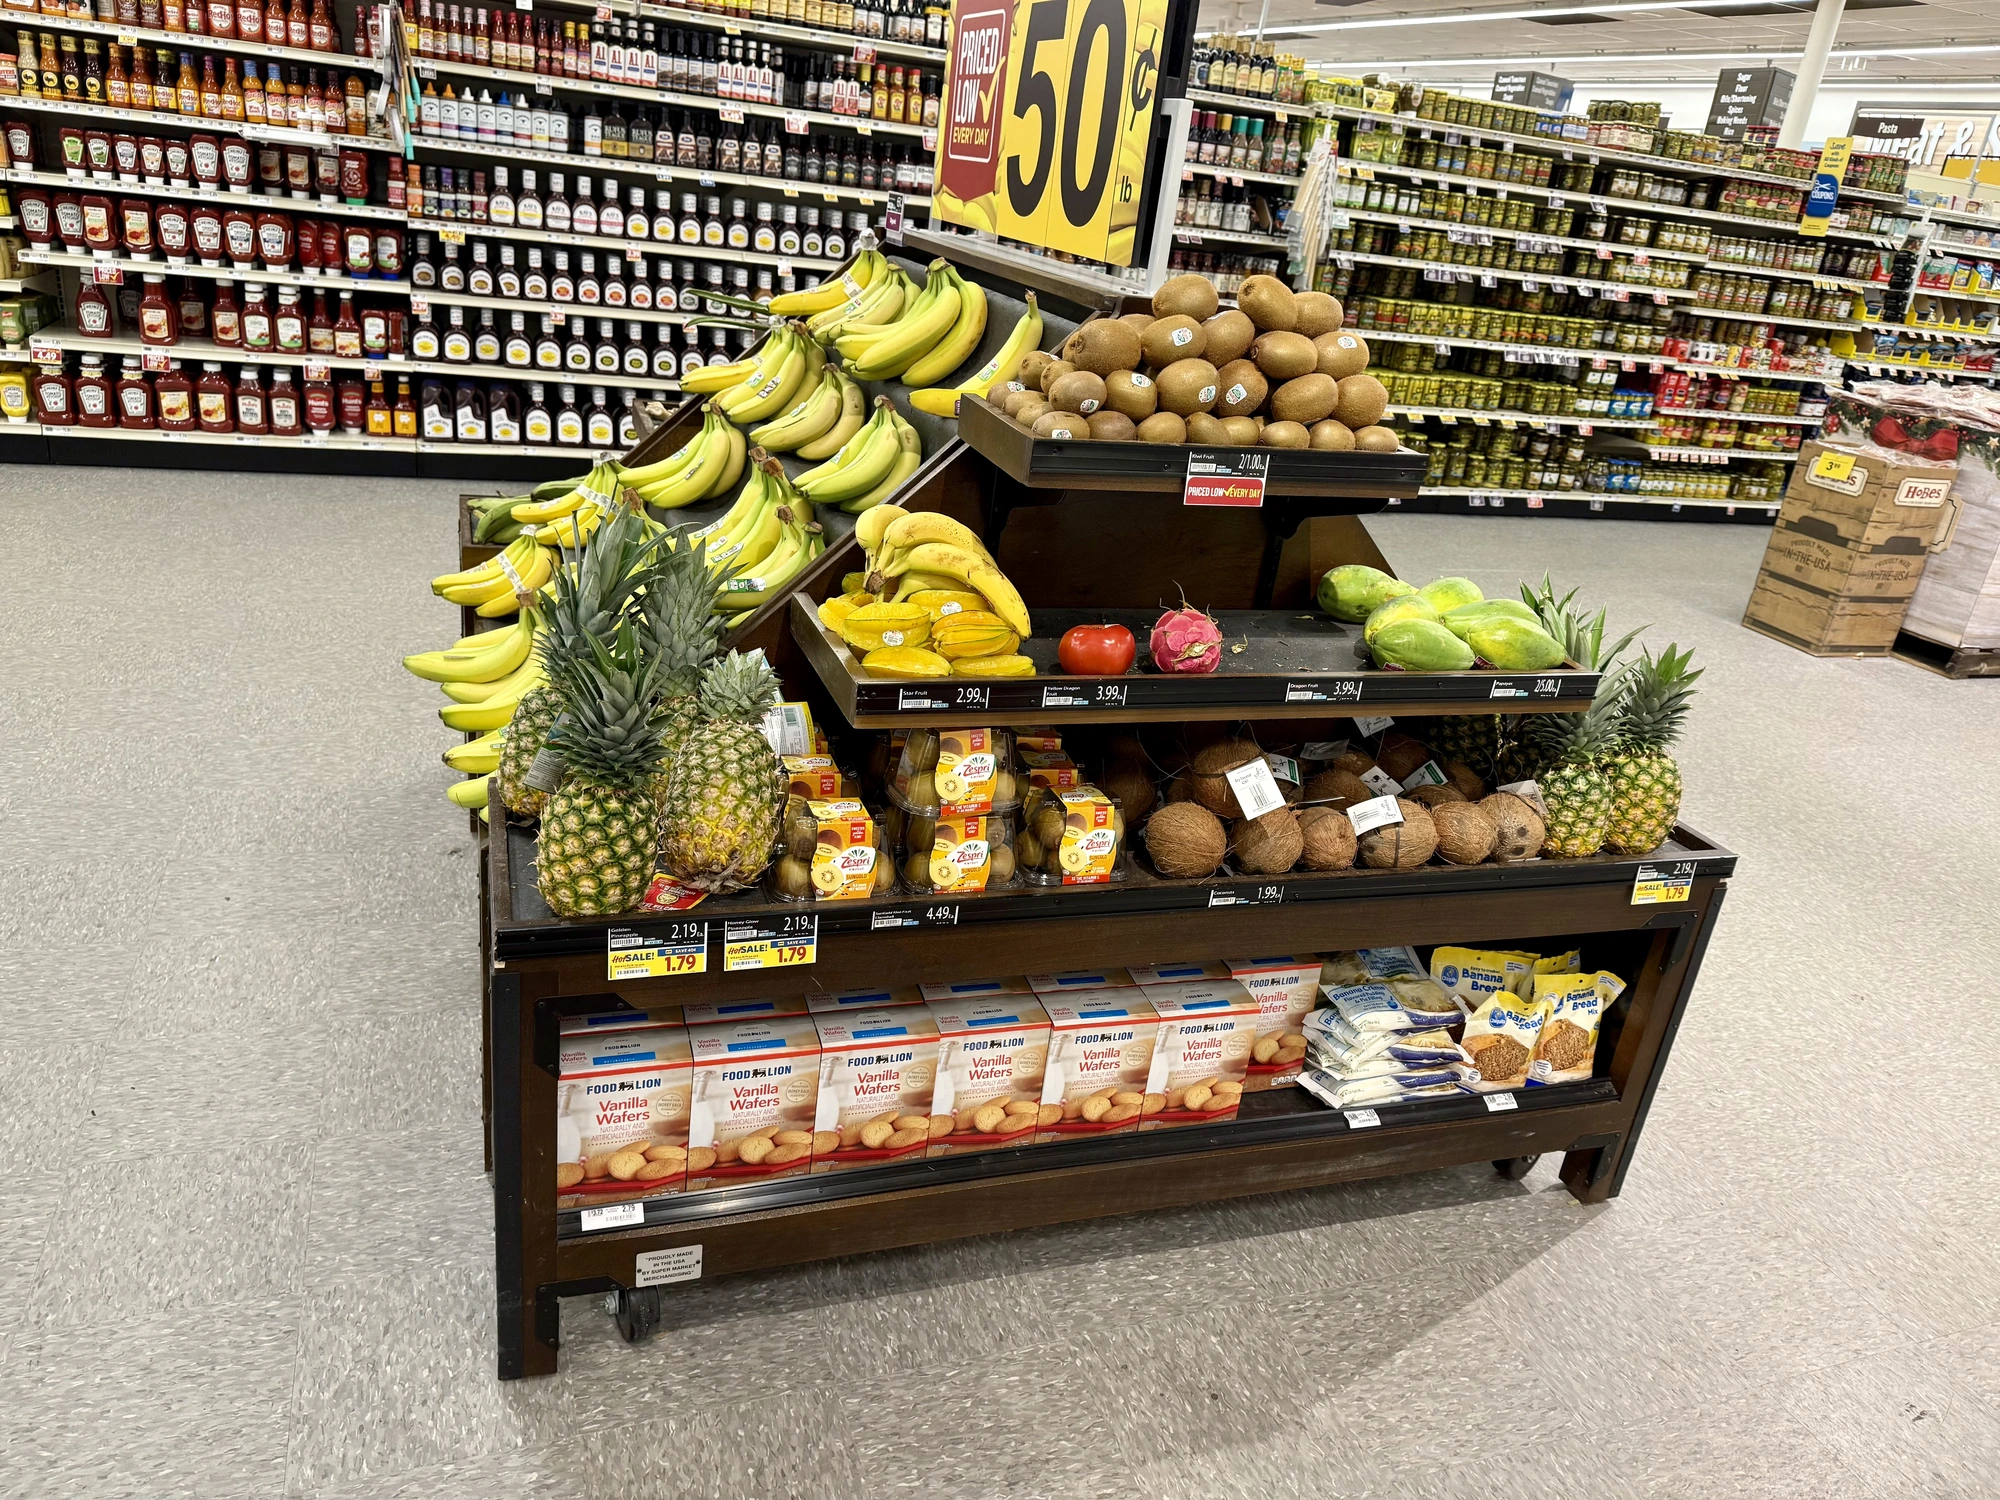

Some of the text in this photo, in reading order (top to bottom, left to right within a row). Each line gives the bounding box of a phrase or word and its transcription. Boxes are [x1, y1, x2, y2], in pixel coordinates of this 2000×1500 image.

[959, 28, 1000, 76] PRICED
[1737, 73, 1752, 82] Sugar
[1735, 84, 1748, 92] Flour
[955, 79, 981, 124] LOW
[1727, 106, 1743, 115] Spices
[1717, 116, 1733, 126] Baking
[1878, 122, 1898, 134] Pasta
[953, 127, 990, 146] EVERY DAY
[1120, 175, 1132, 203] lb
[1811, 190, 1834, 200] COUPONS
[37, 352, 56, 360] 4.49
[1238, 454, 1261, 469] 2/1.00
[1188, 487, 1224, 496] PRICED LOW
[1230, 489, 1261, 498] EVERY DAY
[1816, 543, 1832, 559] MADE
[956, 688, 981, 703] 2.99
[1096, 685, 1118, 701] 3.99
[1333, 682, 1354, 696] 3.99
[963, 764, 990, 776] Zespri
[1085, 839, 1111, 850] Zespri
[841, 856, 871, 869] Zespri
[957, 851, 983, 863] Zespri
[1258, 886, 1277, 899] 1.99
[1666, 887, 1684, 900] 1.79
[926, 906, 949, 920] 4.49
[784, 916, 808, 931] 2.19
[671, 923, 697, 939] 2.19
[777, 946, 806, 963] 1.79
[665, 955, 696, 972] 1.79
[1281, 976, 1299, 985] LION
[1462, 968, 1503, 983] Banana
[1471, 982, 1505, 993] Bread
[1333, 989, 1362, 1001] Banana
[1566, 989, 1595, 1002] Banana
[1572, 998, 1598, 1011] Bread
[1180, 1022, 1235, 1035] FOOD LION
[963, 1038, 1024, 1051] FOOD LION
[1075, 1032, 1133, 1044] FOOD LION
[1187, 1037, 1222, 1050] Vanilla
[848, 1052, 913, 1067] FOOD LION
[1083, 1048, 1120, 1060] Vanilla
[1182, 1049, 1222, 1062] Wafers
[972, 1054, 1012, 1068] Vanilla
[1079, 1059, 1120, 1072] Wafers
[722, 1071, 750, 1081] FOOD
[857, 1069, 899, 1084] Vanilla
[969, 1067, 1012, 1080] Wafers
[733, 1083, 779, 1098] Vanilla
[854, 1082, 900, 1096] Wafers
[730, 1097, 780, 1111] Wafers
[848, 1100, 902, 1111] ARTIFICIALLY FLAVORED
[856, 1095, 884, 1103] NATURALLY
[733, 1110, 762, 1118] NATURALLY
[724, 1115, 782, 1127] ARTIFICIALLY FLAVORED
[591, 1128, 653, 1142] ARTIFICIALLY FLAVORED
[600, 1124, 632, 1133] NATURALLY
